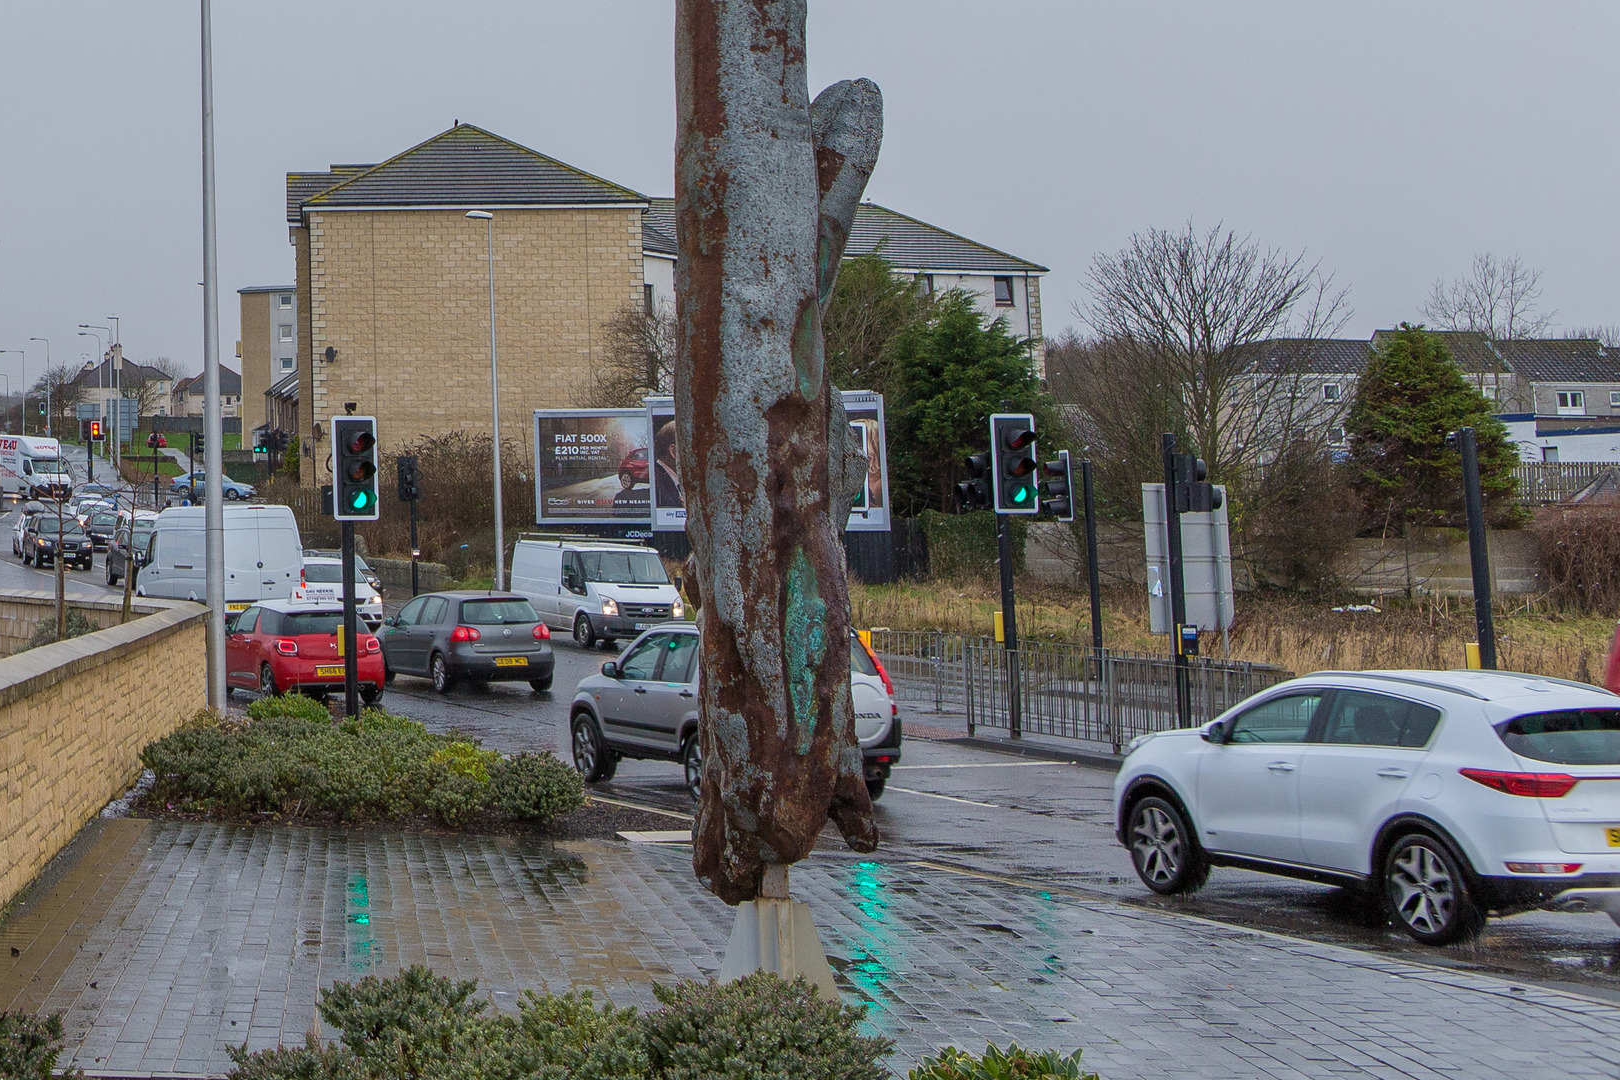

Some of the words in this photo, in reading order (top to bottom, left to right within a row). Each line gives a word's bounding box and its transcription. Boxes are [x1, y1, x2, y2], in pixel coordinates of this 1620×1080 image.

[555, 434, 577, 443] FIAT
[580, 434, 607, 443] 500X
[555, 446, 579, 455] £210
[295, 591, 303, 599] L
